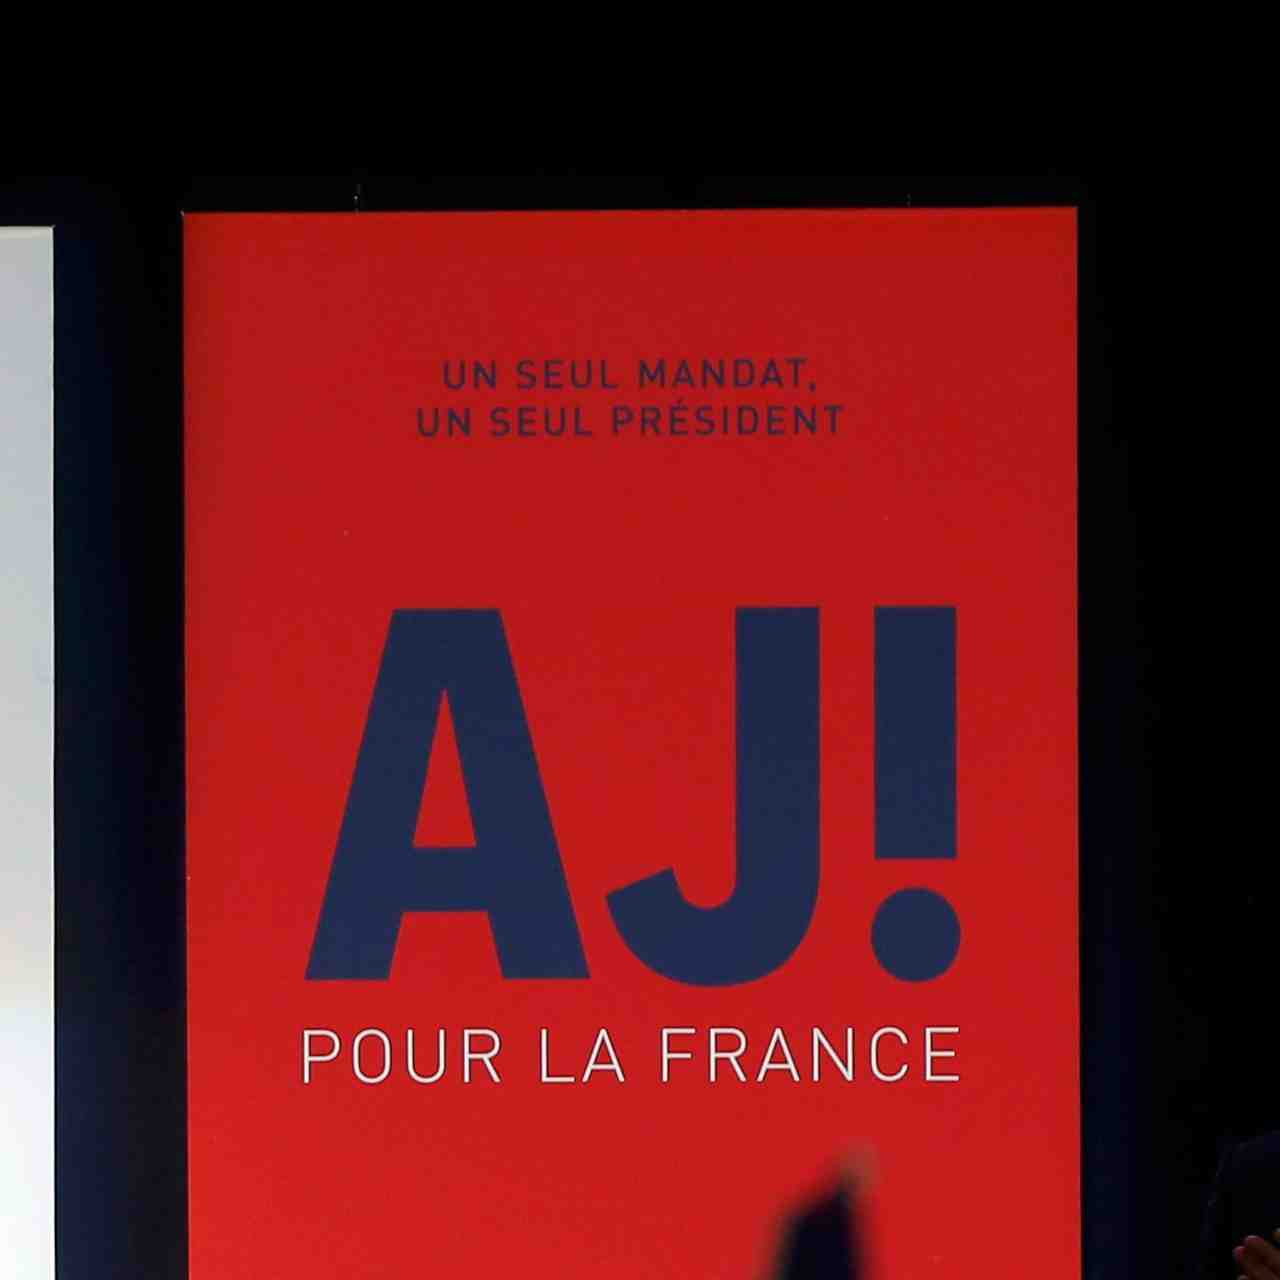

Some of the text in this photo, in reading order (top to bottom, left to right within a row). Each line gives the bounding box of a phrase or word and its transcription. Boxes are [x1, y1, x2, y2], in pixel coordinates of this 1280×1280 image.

[442, 357, 817, 392] UN SEUL MANDAT,
[416, 399, 843, 438] UN SEUL PRÉSIDENT
[304, 605, 961, 988] AJ!
[302, 1026, 961, 1084] POUR LA FRANCE
